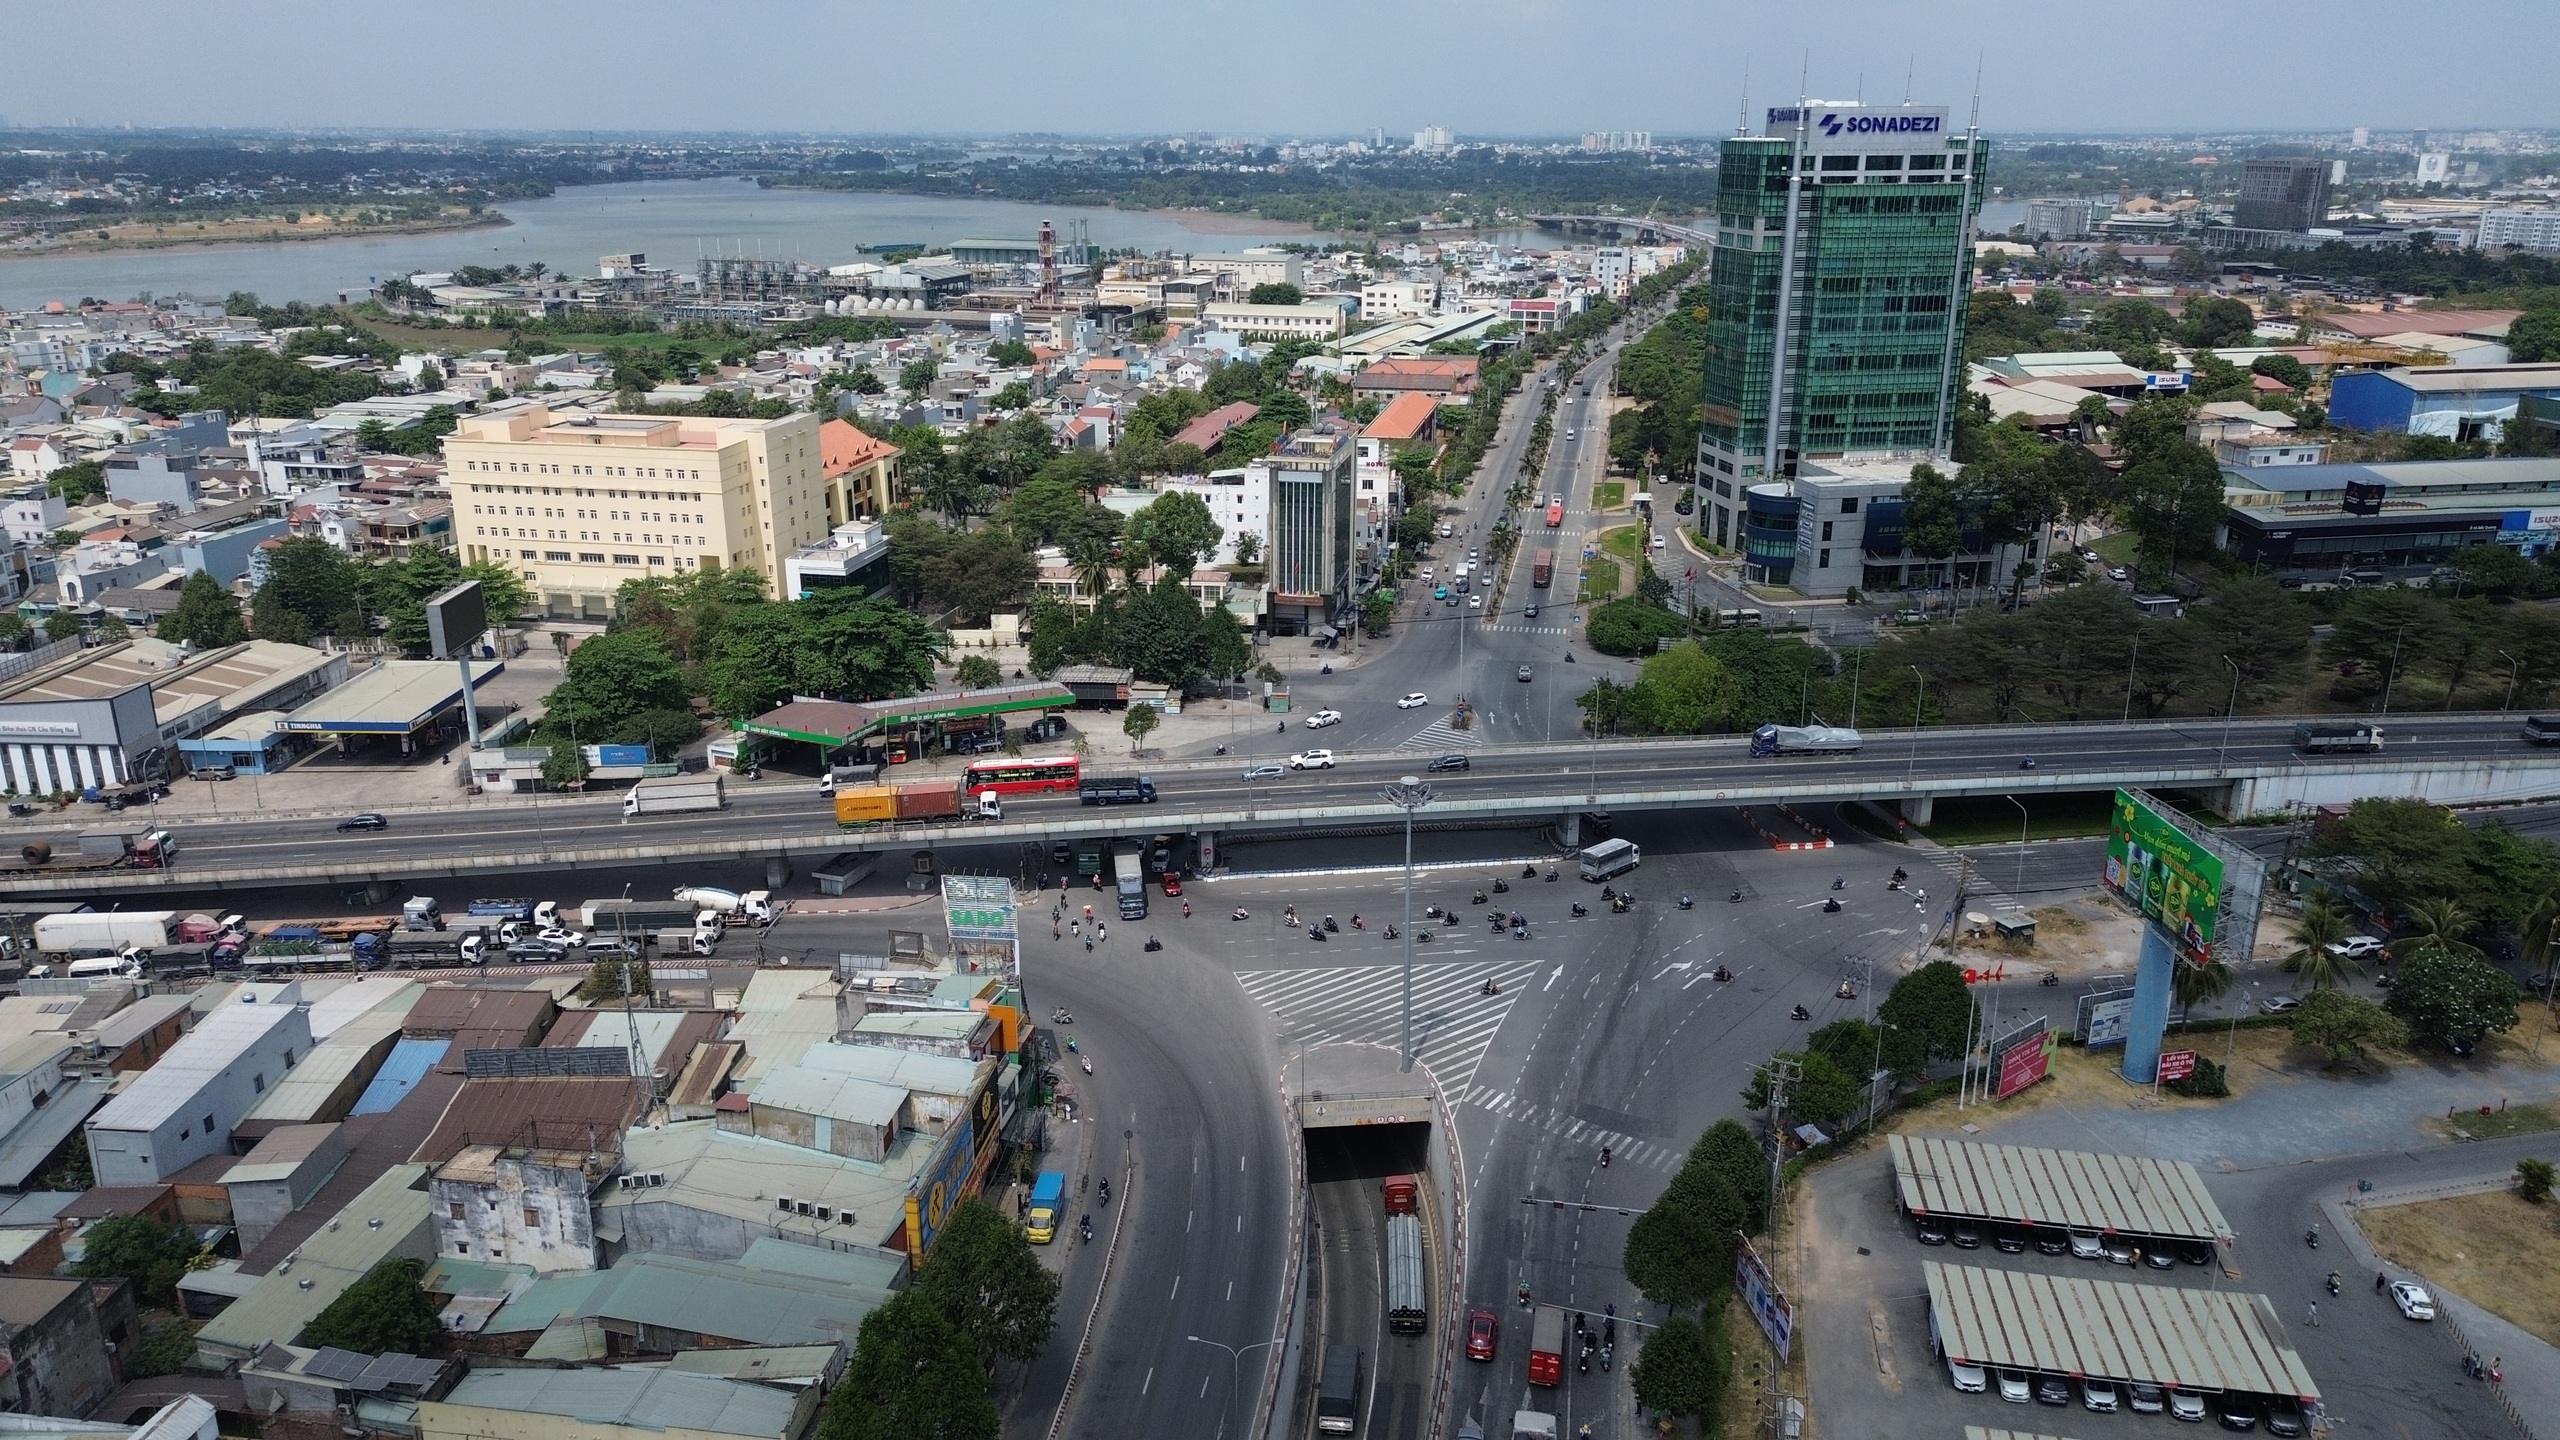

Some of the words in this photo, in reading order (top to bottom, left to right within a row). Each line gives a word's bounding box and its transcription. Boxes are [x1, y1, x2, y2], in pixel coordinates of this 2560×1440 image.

[1847, 116, 1940, 133] SONADEZI
[2534, 515, 2560, 524] ISUZ
[2132, 864, 2141, 875] SP
[2151, 881, 2160, 891] SP
[2170, 896, 2180, 906] SP
[950, 909, 1004, 927] SADO
